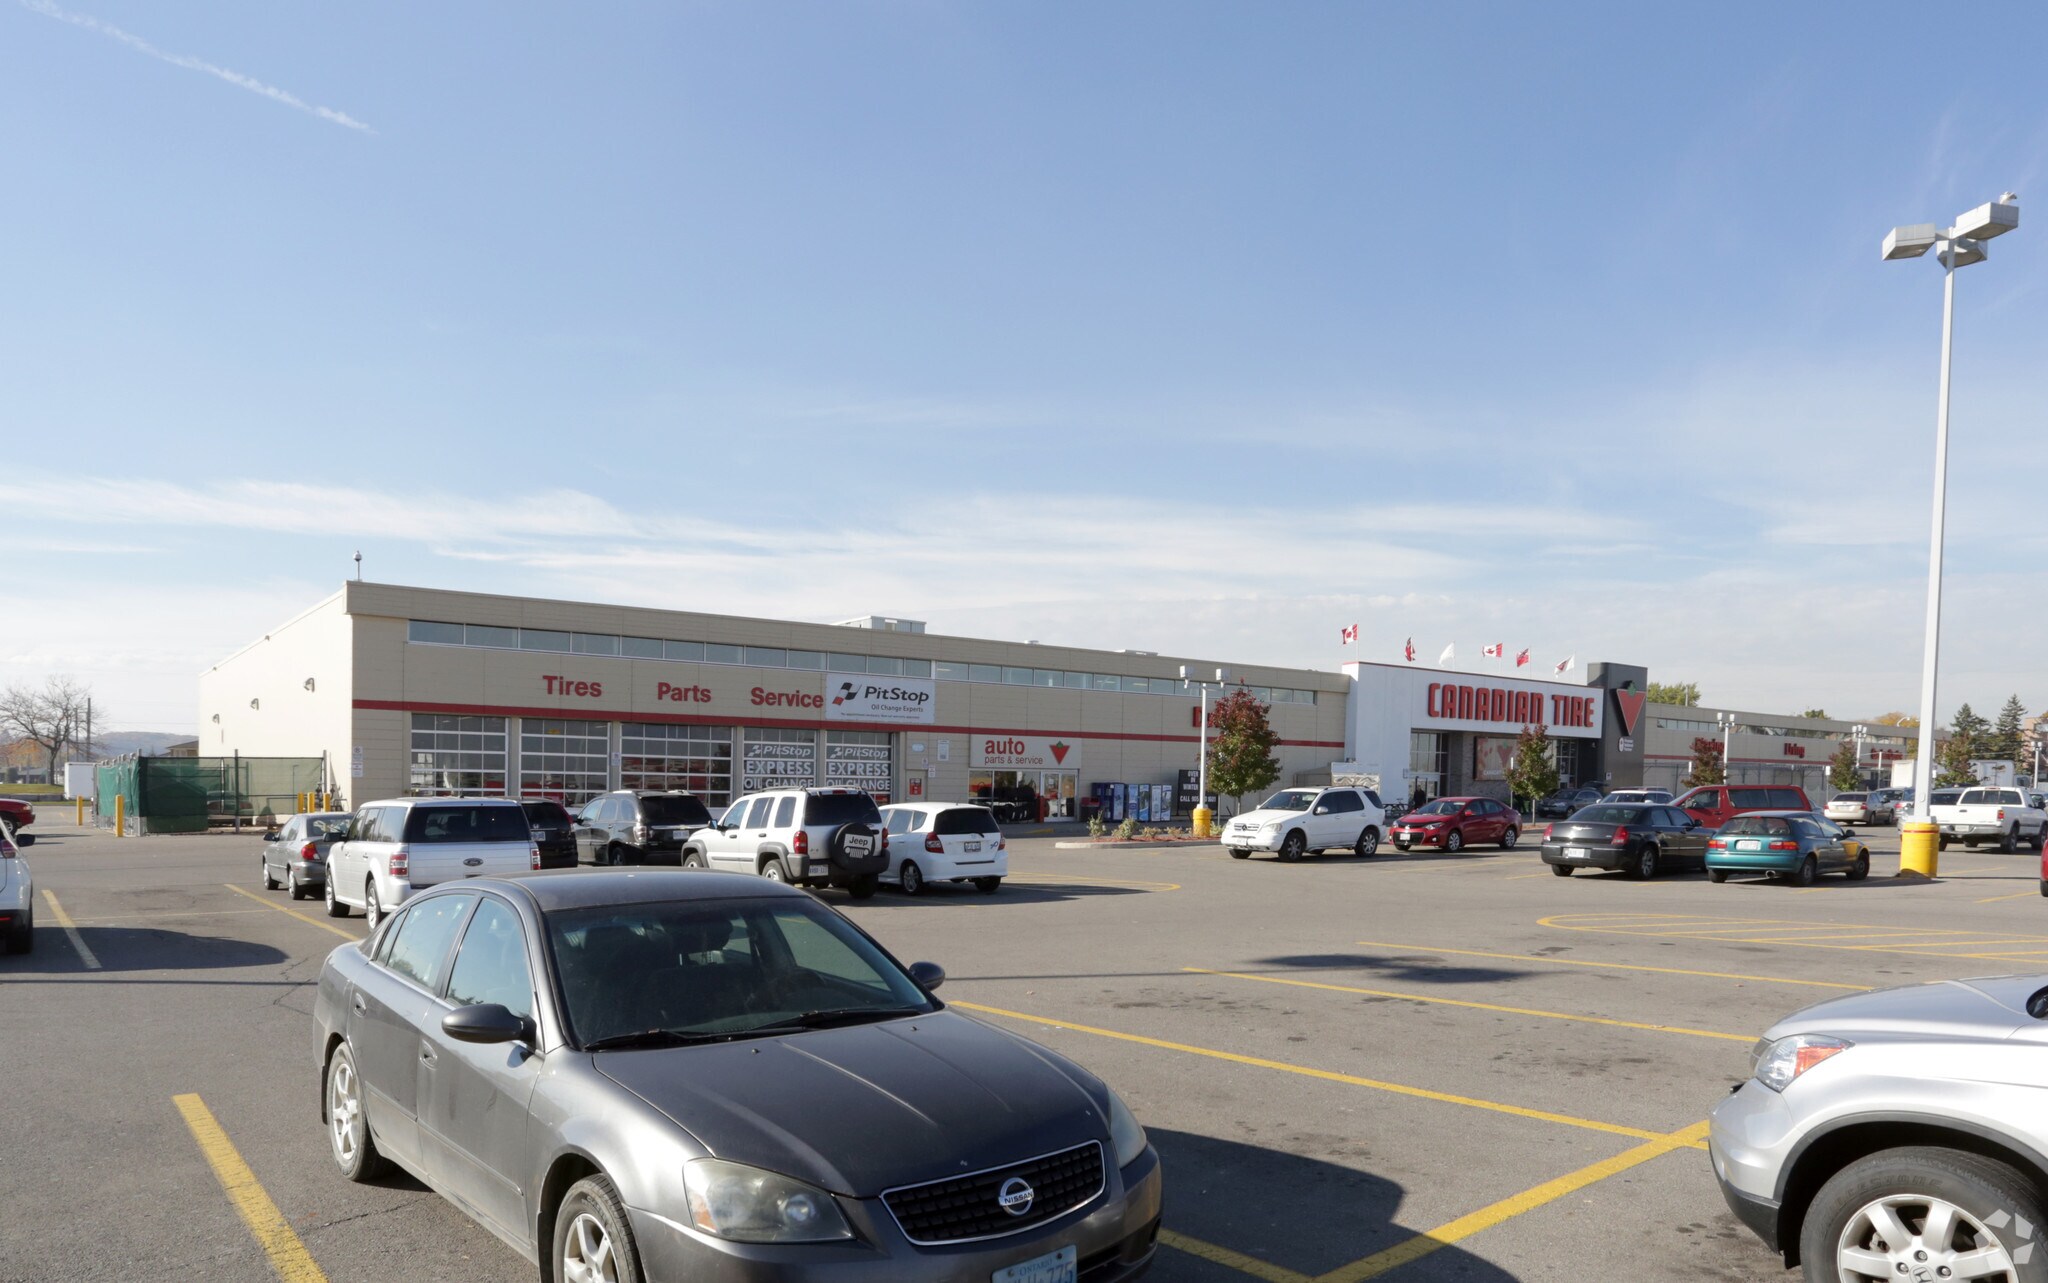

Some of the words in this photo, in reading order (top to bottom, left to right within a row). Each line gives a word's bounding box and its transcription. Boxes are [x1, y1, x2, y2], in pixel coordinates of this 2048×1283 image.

[543, 675, 602, 698] Tires
[657, 682, 712, 703] Parts
[751, 687, 824, 708] Service
[864, 686, 929, 705] PitStop
[881, 704, 902, 712] Change
[1428, 683, 1544, 724] CANADIAN
[1551, 694, 1595, 727] TIRE
[763, 745, 811, 757] PitStop
[985, 738, 1025, 755] auto
[844, 748, 889, 759] PitStop
[985, 755, 1004, 765] parts
[1007, 756, 1012, 764] &
[1015, 756, 1043, 765] service
[746, 761, 812, 775] EXPRESS
[828, 762, 889, 776] EXPRESS
[744, 779, 762, 789] OIL
[765, 779, 814, 789] CHANGE
[827, 780, 843, 788] OIL
[846, 779, 890, 790] CHANGE
[849, 836, 869, 847] Jeep
[1004, 1191, 1033, 1204] NISSAN
